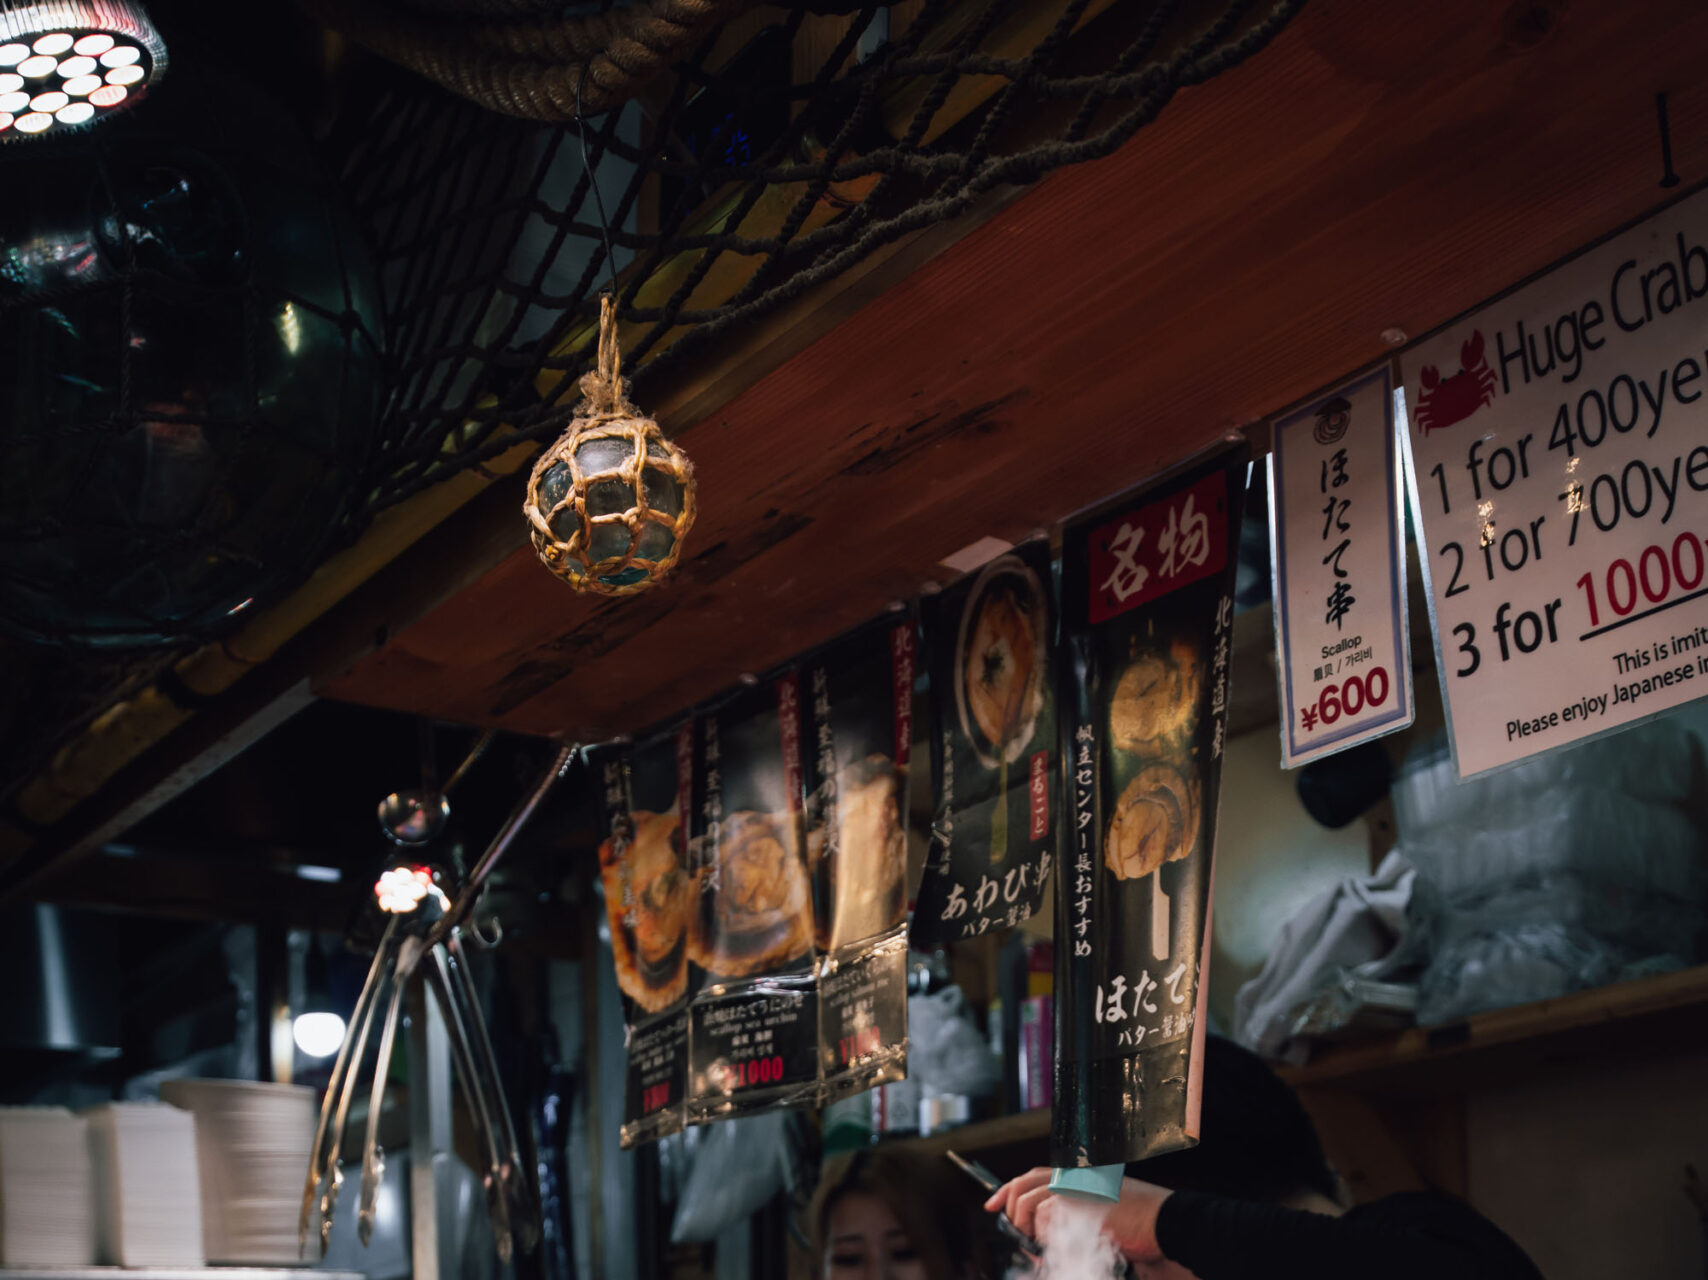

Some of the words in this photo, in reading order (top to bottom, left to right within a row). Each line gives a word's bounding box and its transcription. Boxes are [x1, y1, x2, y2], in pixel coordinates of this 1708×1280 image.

[1495, 300, 1607, 395] Huge
[1610, 231, 1708, 332] Crab
[1429, 462, 1451, 515] 1
[1466, 432, 1533, 500] for
[1547, 349, 1708, 457] 400ye
[1098, 492, 1211, 603] 名物
[1319, 446, 1357, 631] ほたて串
[1439, 541, 1470, 599] 2
[1479, 515, 1546, 581] for
[1451, 621, 1482, 679] 3
[1492, 597, 1562, 662] for
[1576, 531, 1708, 627] 1000
[1321, 635, 1362, 659] Scallop
[1612, 649, 1650, 675] This
[1653, 642, 1669, 663] is
[1300, 666, 1389, 731] ¥600
[1506, 711, 1559, 741] Please
[1562, 692, 1608, 721] enjoy
[1612, 664, 1694, 705] Japanese
[940, 849, 1053, 921] あわび串
[1095, 962, 1198, 1023] ほたて
